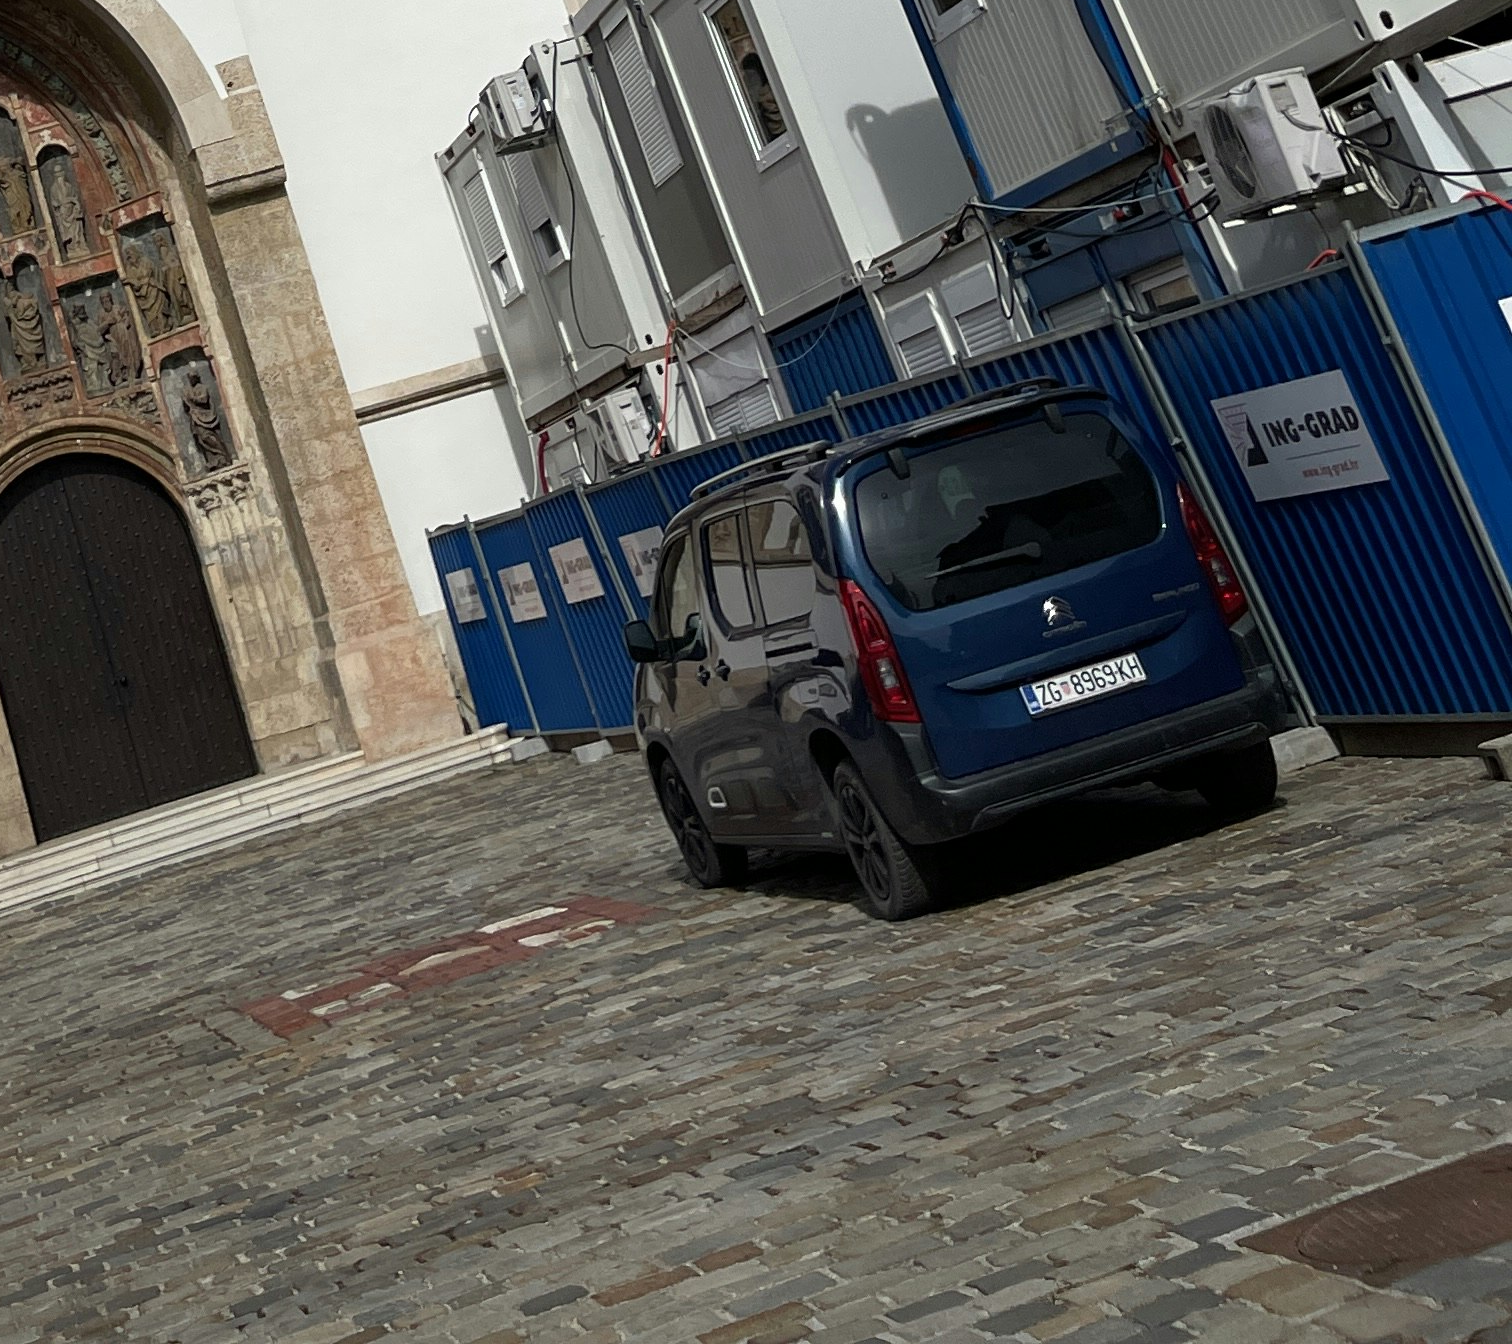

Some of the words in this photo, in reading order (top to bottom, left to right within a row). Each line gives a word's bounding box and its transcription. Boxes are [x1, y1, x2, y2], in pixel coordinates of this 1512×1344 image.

[1261, 405, 1360, 448] ING-GRAD
[1036, 681, 1063, 706] ZG
[1070, 657, 1143, 695] 8969-KH
